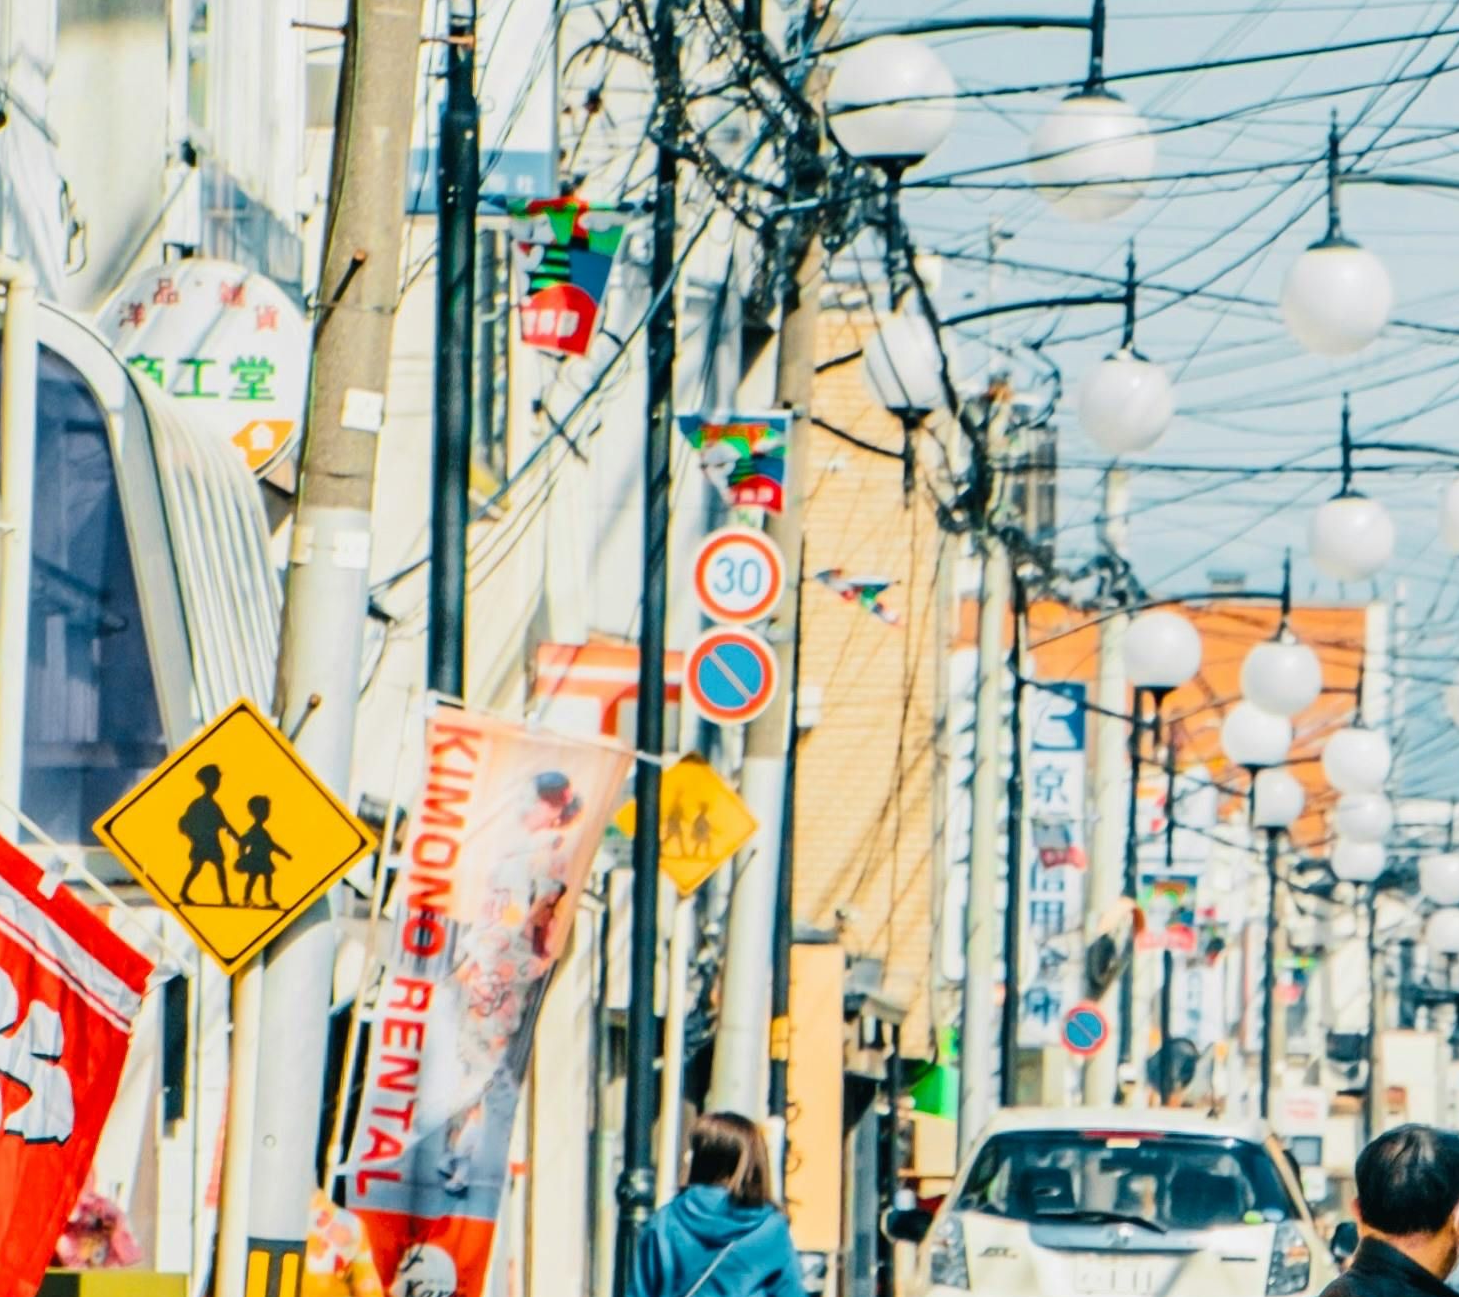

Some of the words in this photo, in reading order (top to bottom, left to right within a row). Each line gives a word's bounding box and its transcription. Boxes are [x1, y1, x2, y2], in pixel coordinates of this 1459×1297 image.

[713, 556, 763, 597] 30
[398, 723, 484, 959] KIMONO
[356, 976, 435, 1198] RENTAL
